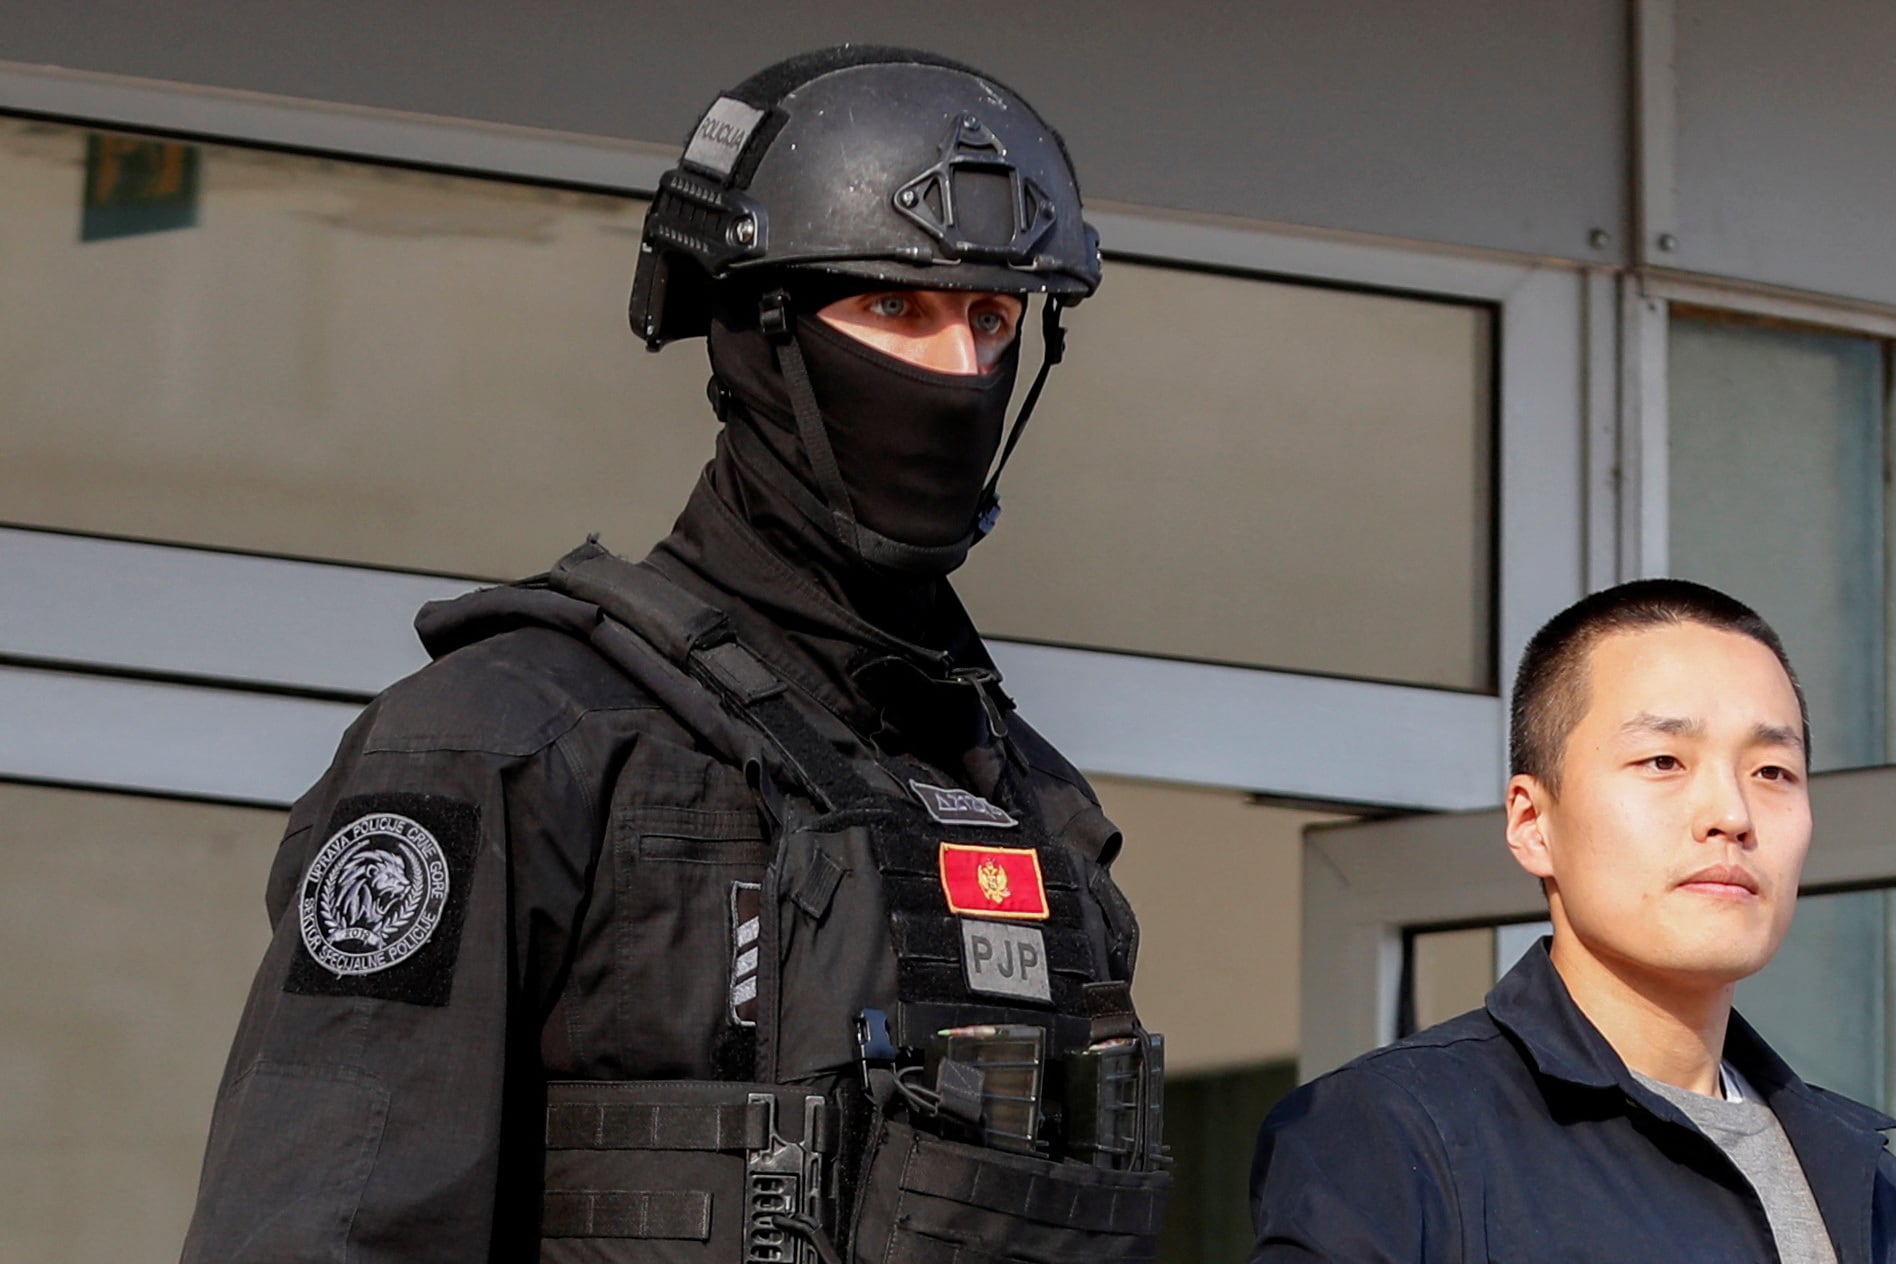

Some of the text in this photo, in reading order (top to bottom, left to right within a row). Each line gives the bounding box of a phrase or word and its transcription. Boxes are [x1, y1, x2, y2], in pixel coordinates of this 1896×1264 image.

[699, 117, 746, 150] POLICIJA
[308, 817, 445, 900] UPRAVA POLICIJE CRNE GORE
[303, 897, 437, 971] SEKTOR SPECIJALNE POLICIJE
[971, 935, 1039, 981] PJP
